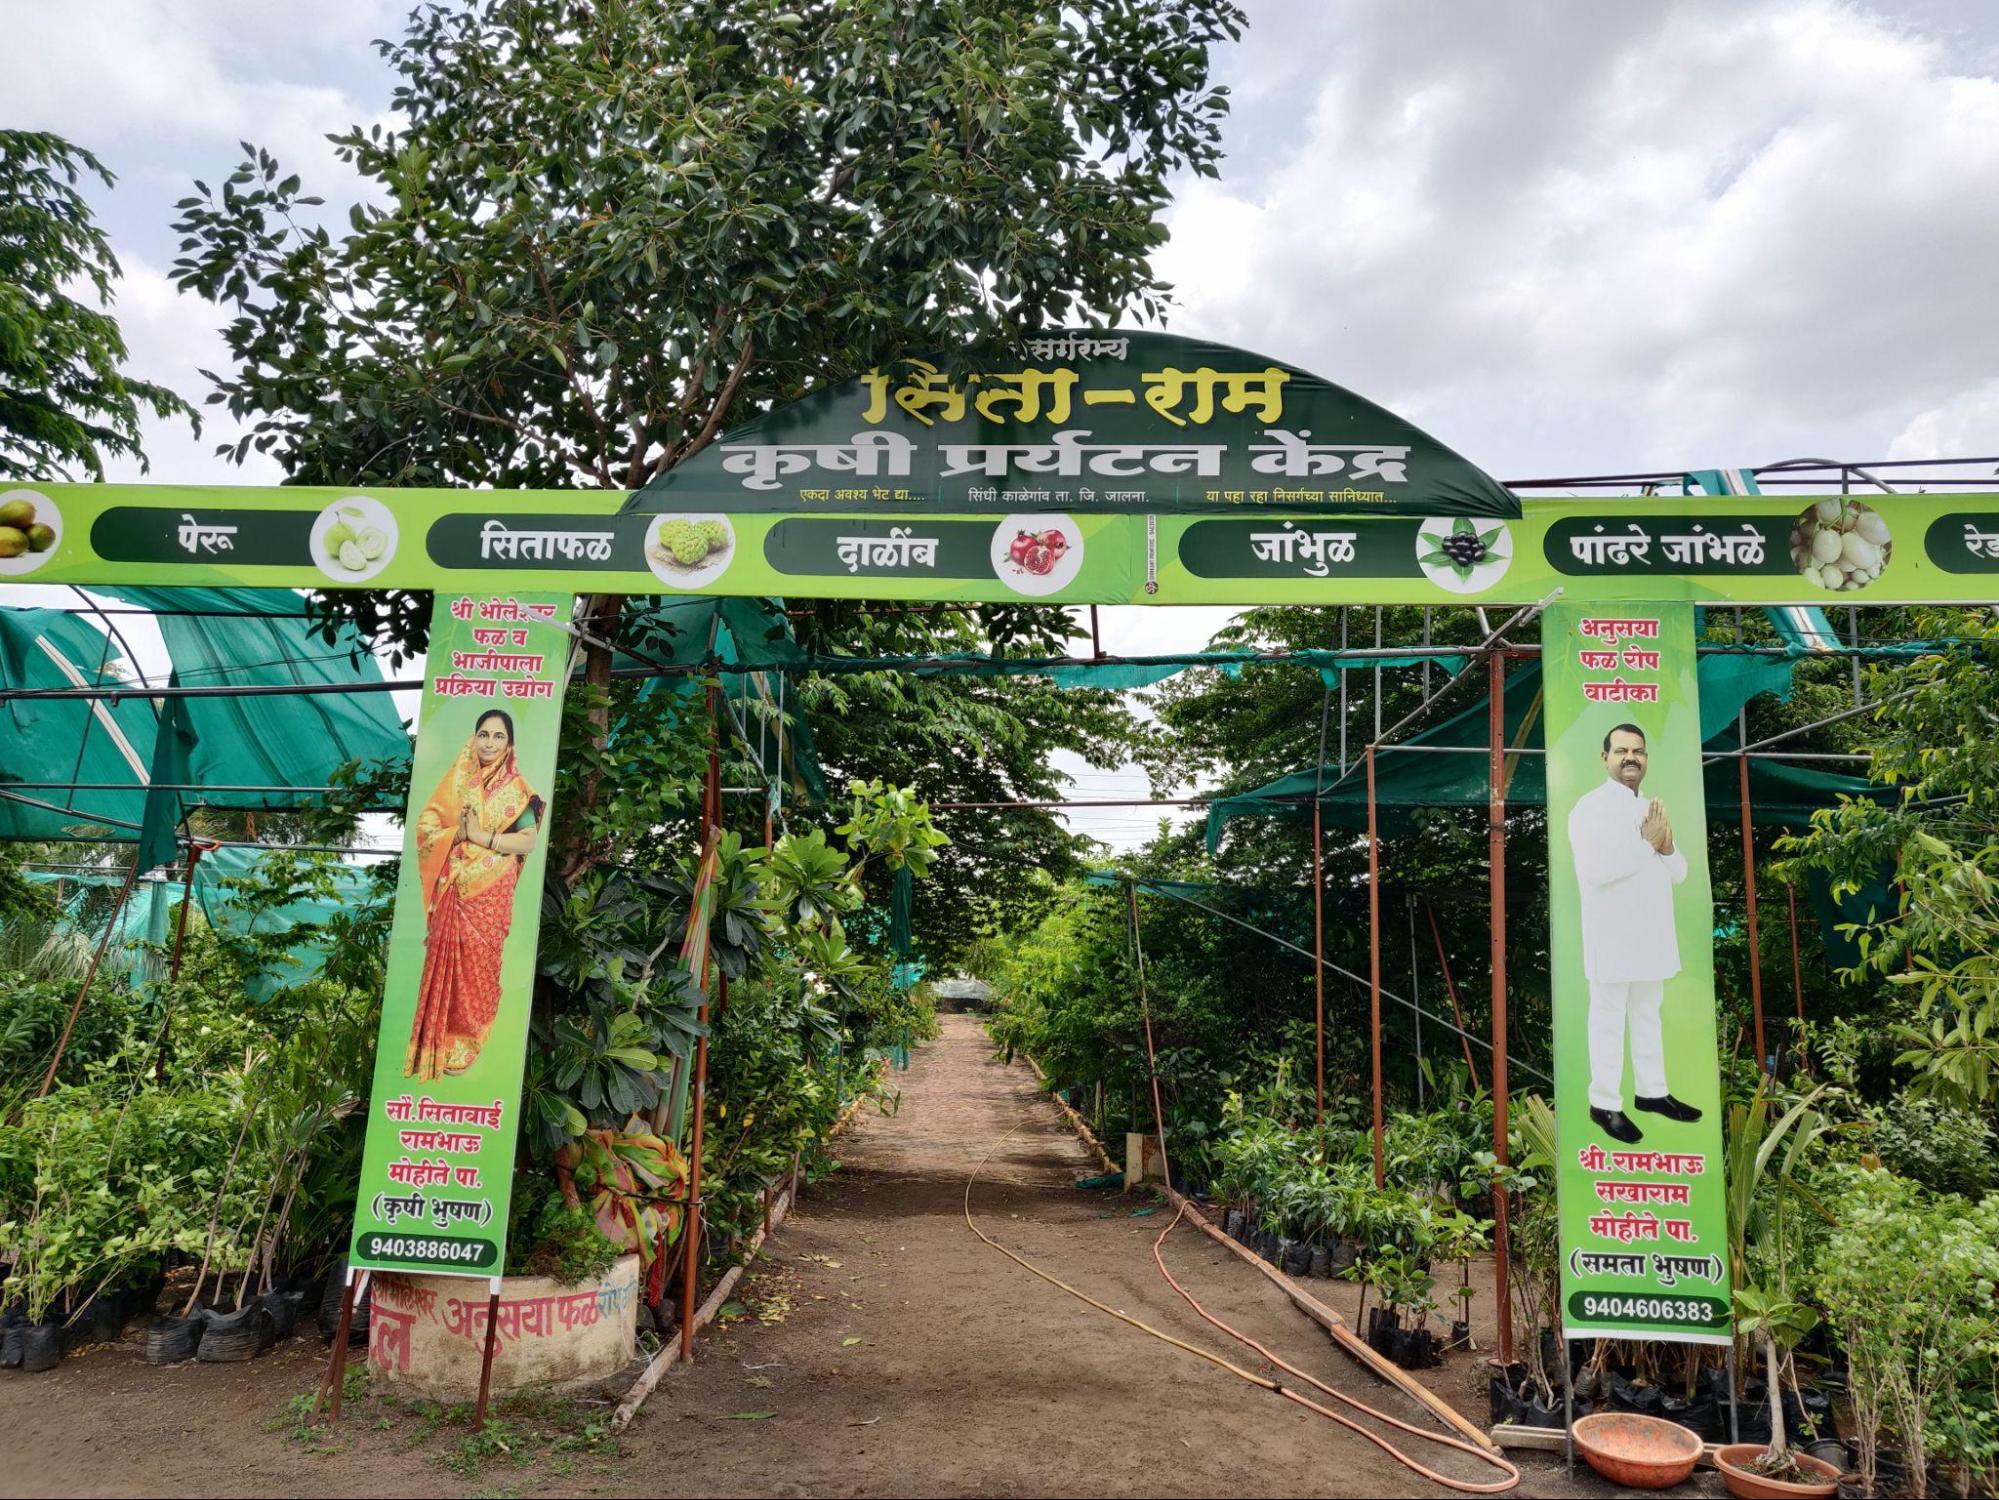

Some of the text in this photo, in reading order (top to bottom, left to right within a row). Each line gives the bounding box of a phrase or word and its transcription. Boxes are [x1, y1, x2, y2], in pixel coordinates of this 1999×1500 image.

[720, 429, 1411, 490] कृषी प्रर्यटन केंद्र
[800, 489, 830, 502] एकदा
[834, 489, 868, 501] अवश्य
[872, 485, 890, 501] भेट
[968, 486, 1150, 502] सिंधी काळेगांव ता. जि. जालना.
[1206, 491, 1220, 502] या
[1224, 491, 1245, 504] पहा
[1249, 491, 1269, 504] रहा
[1273, 487, 1324, 502] निसर्गच्या
[178, 513, 238, 555] पेरू
[480, 520, 615, 562] सिताफळ
[1569, 523, 1766, 566] पांढरे जांभळे
[836, 526, 939, 573] दाळींब
[1250, 520, 1358, 576] जांभुळ
[451, 597, 474, 620] श्री
[473, 628, 528, 646] फळ व
[1580, 618, 1660, 645] अनुसया
[452, 648, 543, 673] भाजीपाला
[1579, 643, 1660, 671] फळ रोप
[434, 672, 554, 698] प्रक्रिया उद्योग
[1583, 676, 1659, 703] वाटीका
[400, 1130, 481, 1153] रामभाऊ
[388, 1156, 483, 1188] मोहीते पा.
[1594, 1181, 1690, 1206] सखाराम
[372, 1191, 493, 1229] (कृषी भुषण)
[1590, 1210, 1698, 1244] मोहीते पा.
[370, 1236, 484, 1263] 9403886047
[1569, 1247, 1726, 1287] (समता भुषण)
[1583, 1296, 1714, 1322] 9404606383
